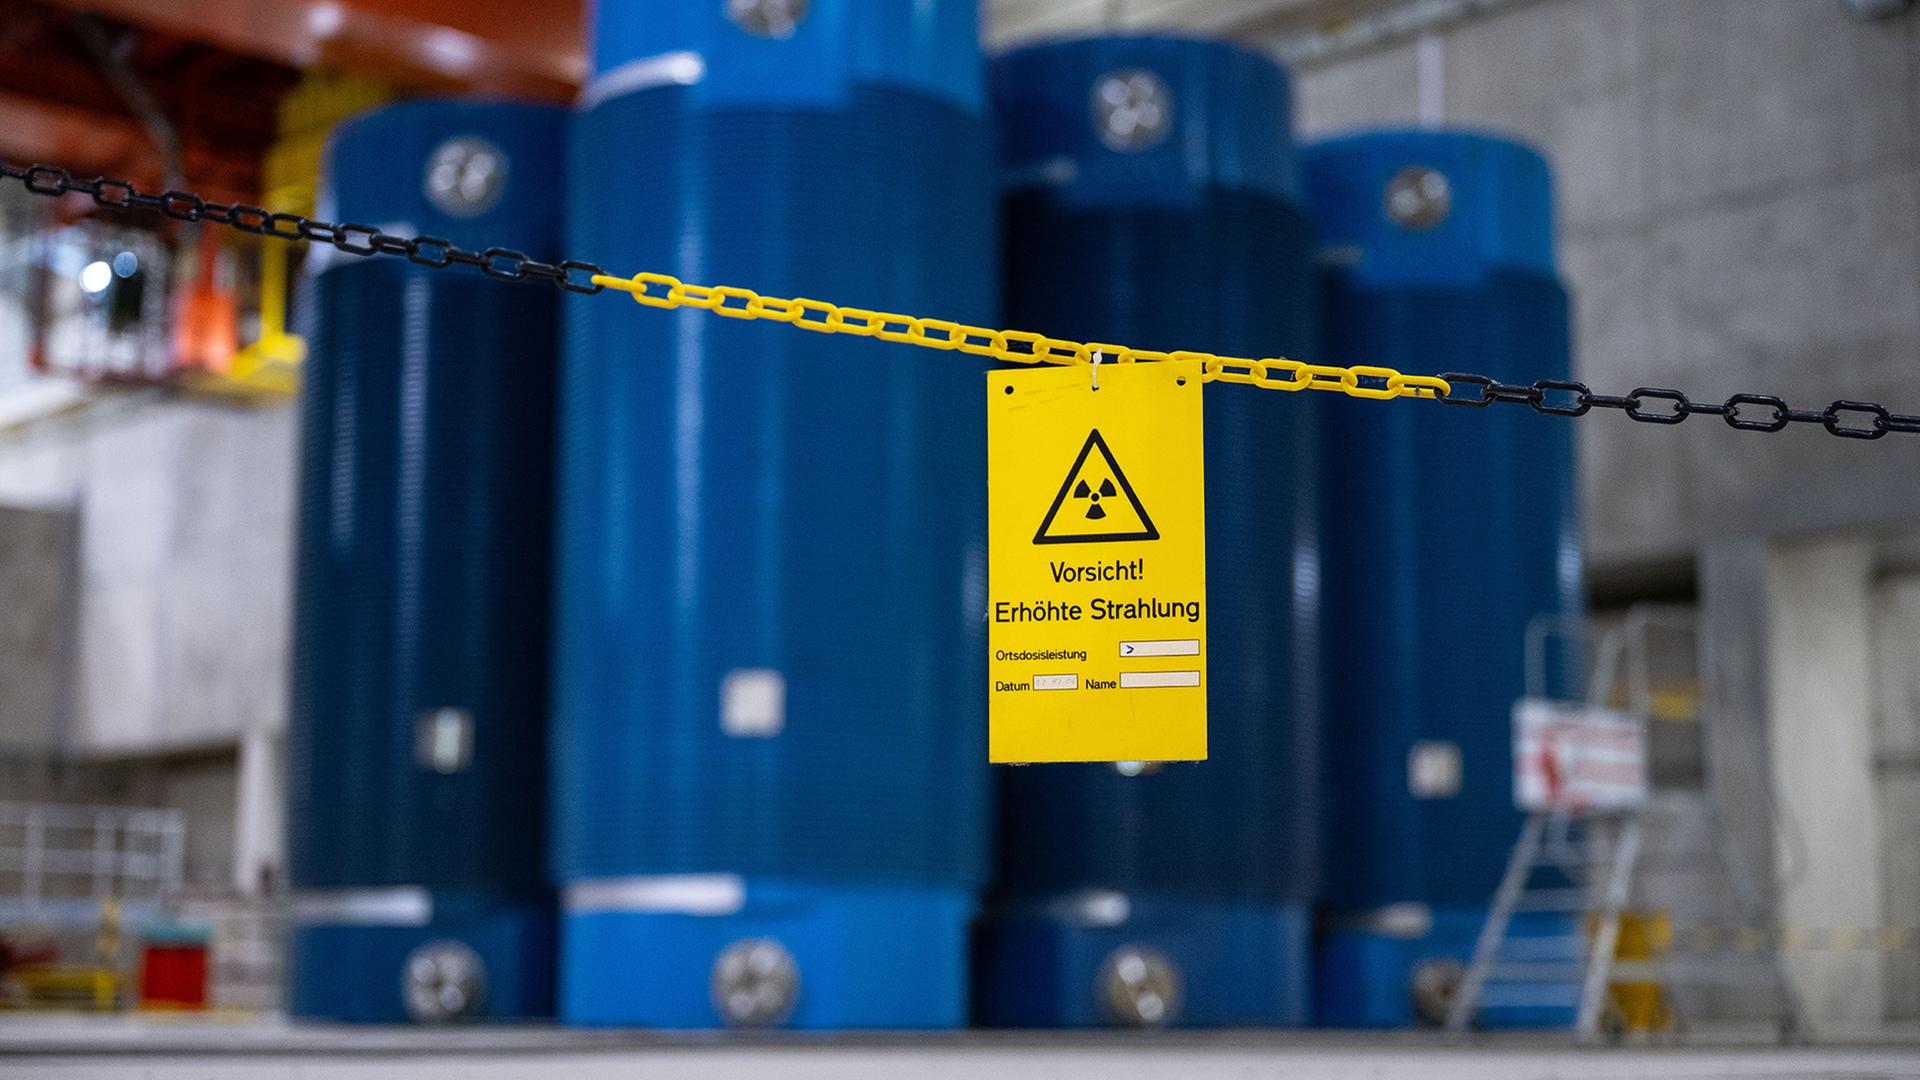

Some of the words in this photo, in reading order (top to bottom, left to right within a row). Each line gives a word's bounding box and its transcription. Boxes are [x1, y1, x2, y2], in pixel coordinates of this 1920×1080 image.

[1050, 558, 1143, 583] Vorsicht!
[996, 602, 1082, 622] Erhöhte
[1091, 598, 1200, 622] Strahlung
[996, 649, 1087, 661] Ortsdosisleistung
[996, 680, 1030, 692] Datum
[1085, 679, 1117, 690] Name
